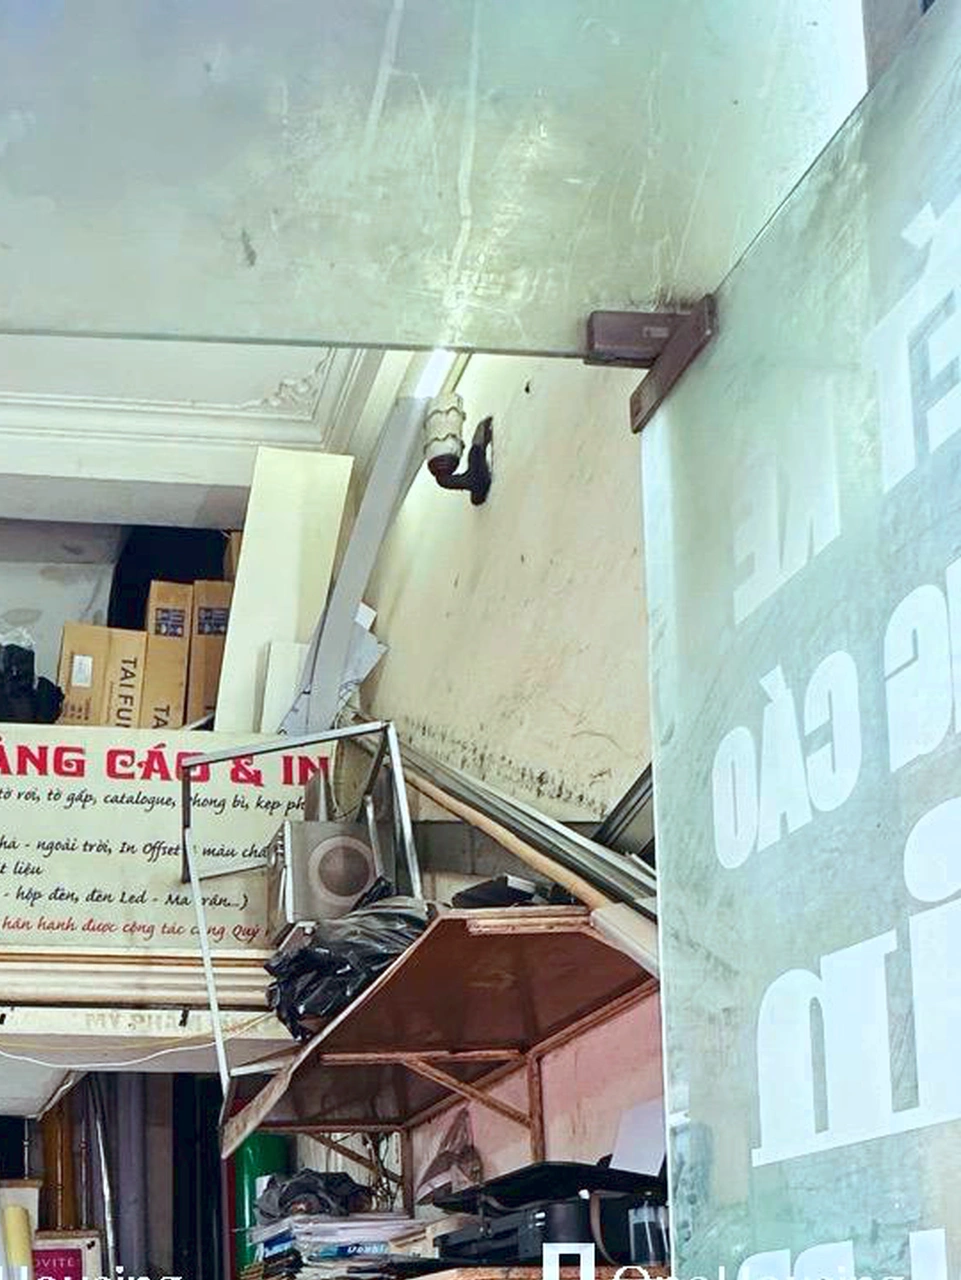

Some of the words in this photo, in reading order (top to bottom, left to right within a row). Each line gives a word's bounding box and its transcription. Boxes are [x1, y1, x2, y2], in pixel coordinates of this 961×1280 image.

[120, 657, 138, 689] TAI
[106, 743, 210, 784] CÁO
[103, 791, 176, 812] catalogue,
[189, 793, 226, 815] hong
[119, 842, 138, 854] In
[142, 841, 180, 863] Offset
[13, 862, 45, 877] liệu
[120, 890, 147, 904] Led
[161, 923, 185, 936] tác
[191, 925, 226, 943] cng
